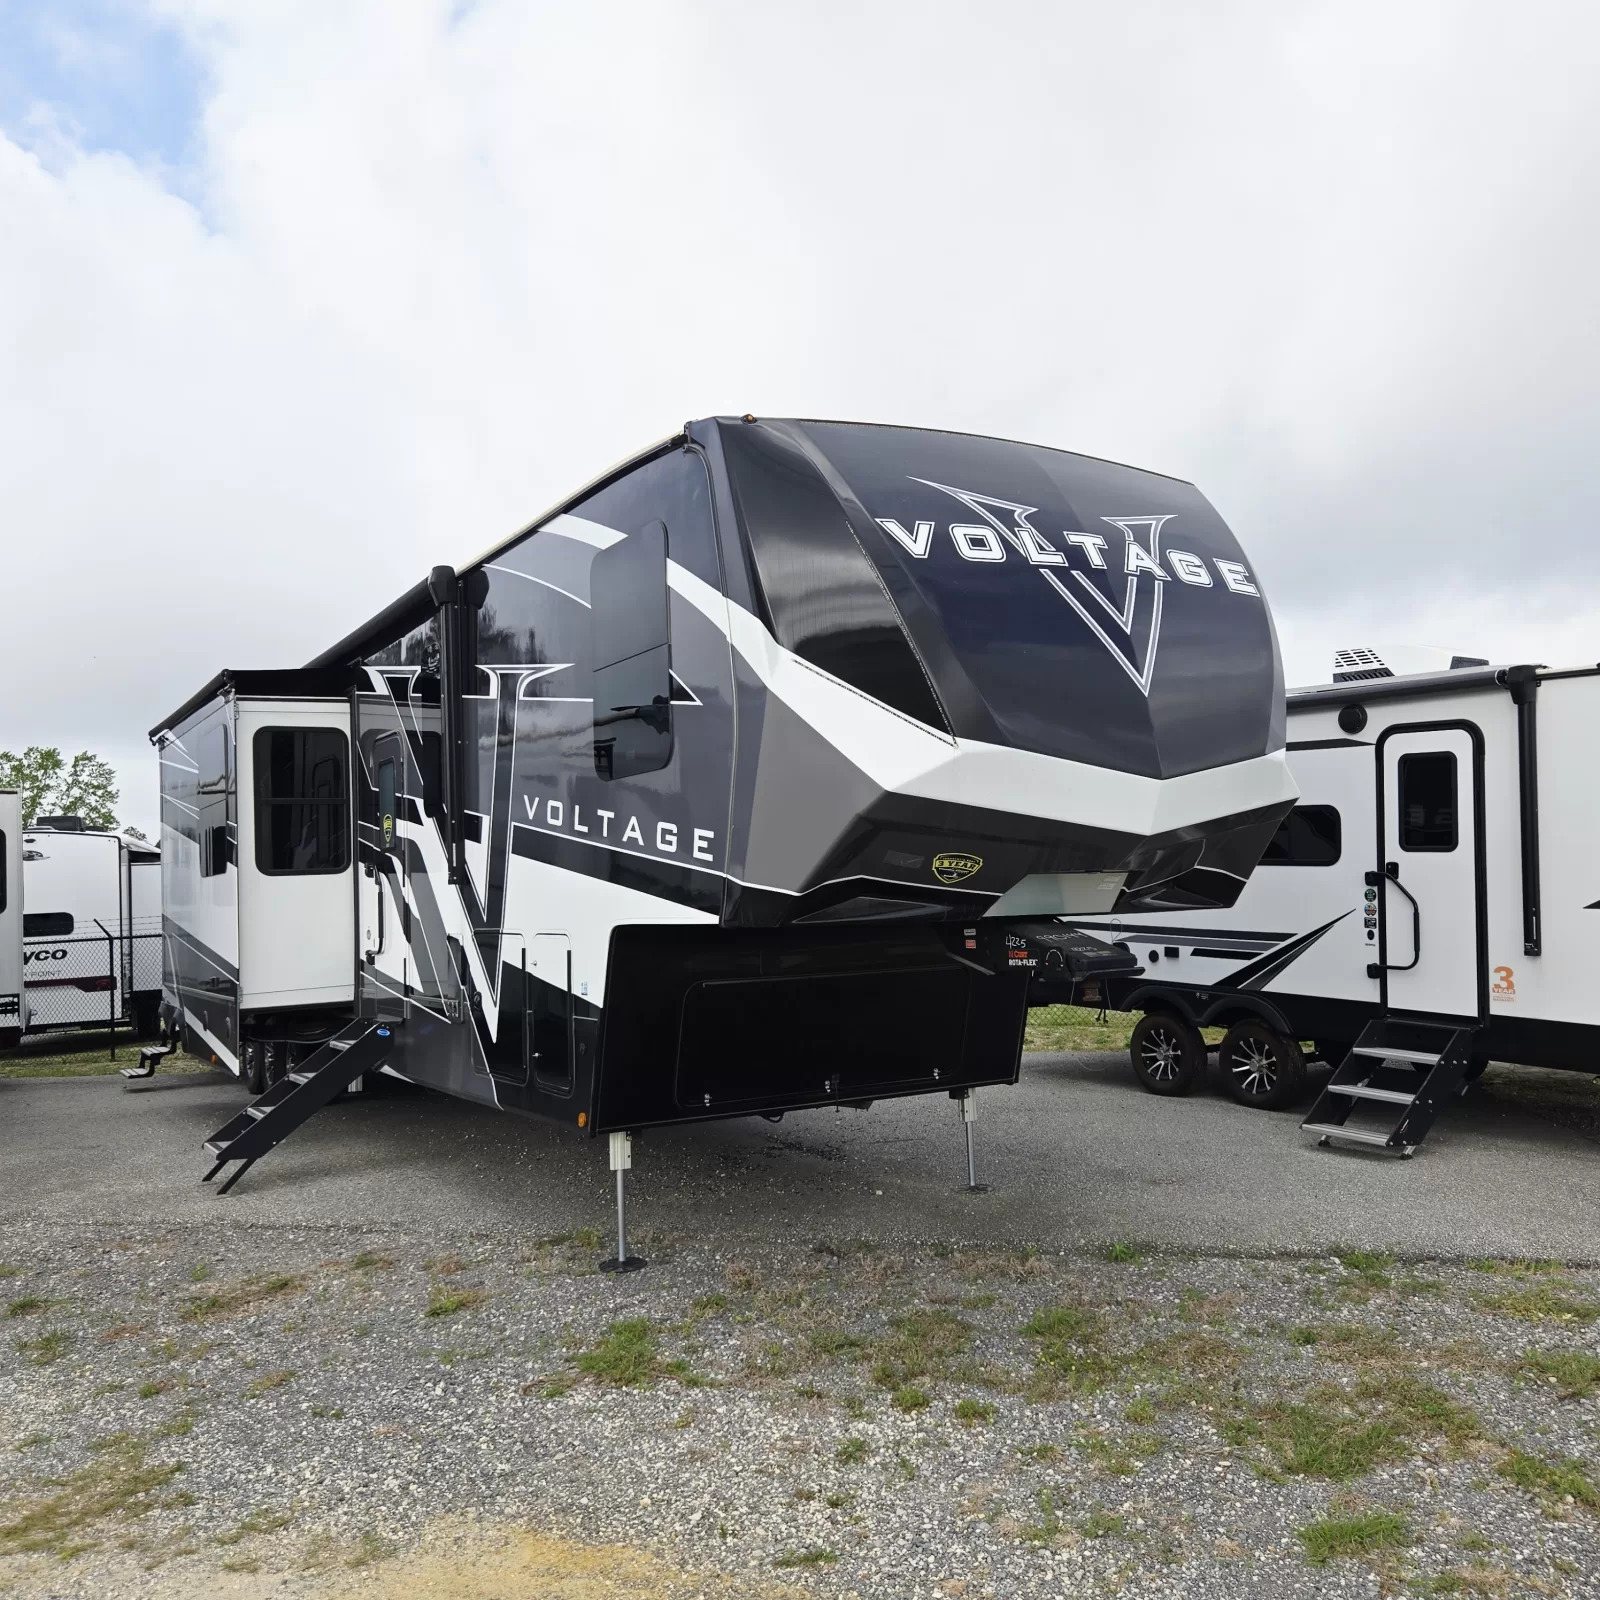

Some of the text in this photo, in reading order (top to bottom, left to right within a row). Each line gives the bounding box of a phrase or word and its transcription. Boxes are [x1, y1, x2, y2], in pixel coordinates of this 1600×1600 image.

[875, 517, 1260, 597] VOLTAGE
[523, 794, 715, 862] VOLTAGE
[948, 860, 977, 871] YEAR
[1493, 966, 1514, 989] 3
